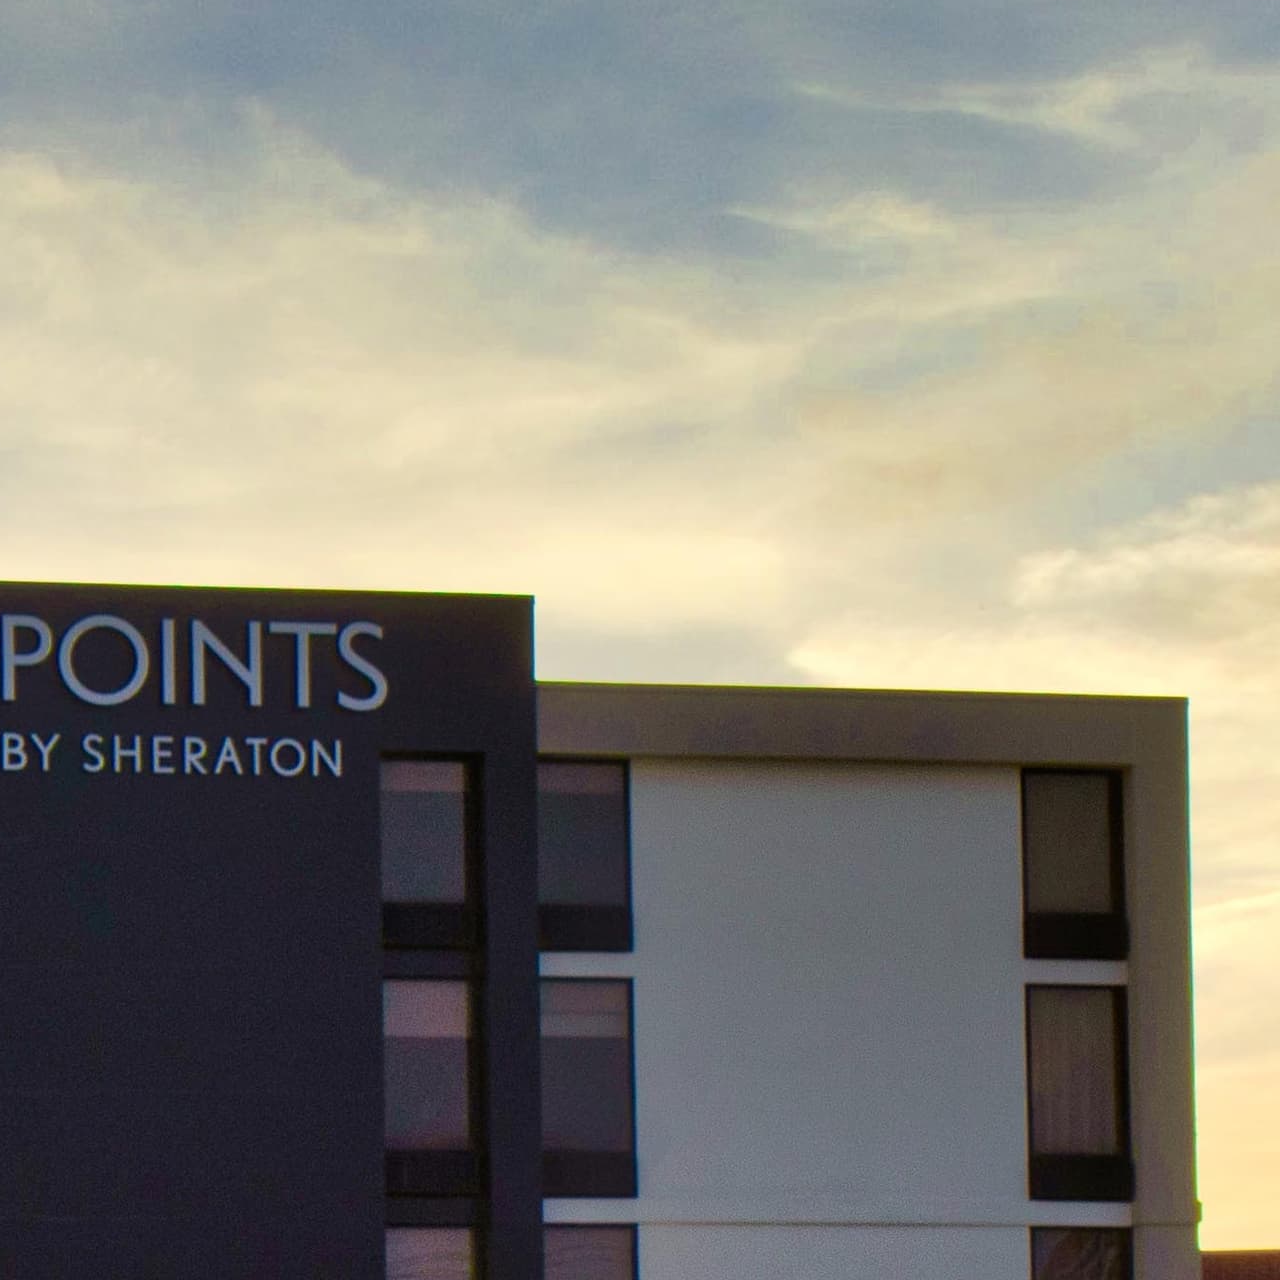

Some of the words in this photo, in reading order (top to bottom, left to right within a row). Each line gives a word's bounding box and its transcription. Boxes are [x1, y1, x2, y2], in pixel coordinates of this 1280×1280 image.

[1, 614, 389, 711] POINTS
[2, 732, 60, 772] BY
[82, 734, 343, 778] SHERATON
